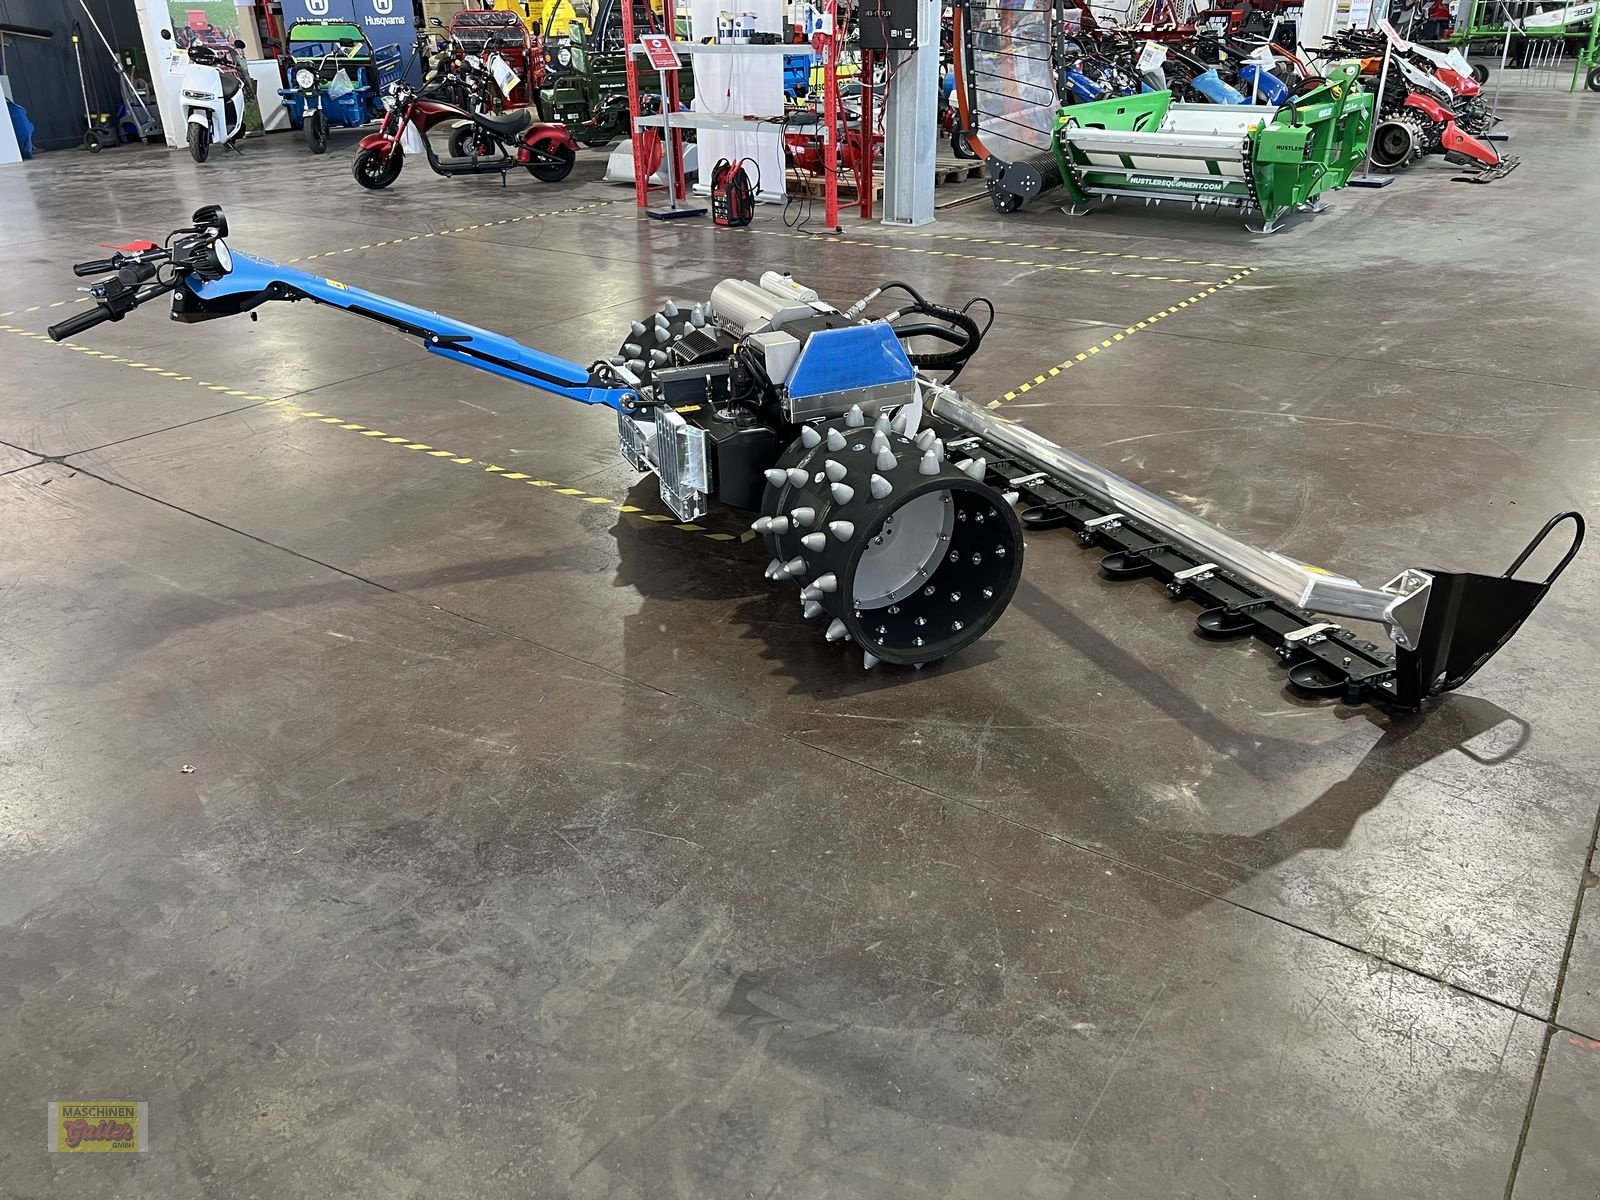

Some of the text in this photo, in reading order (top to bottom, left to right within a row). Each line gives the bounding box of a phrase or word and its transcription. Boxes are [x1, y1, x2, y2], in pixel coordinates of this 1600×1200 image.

[1574, 7, 1593, 17] 350
[364, 15, 406, 26] Husqvarna
[1130, 177, 1222, 190] HUSTLEREQUIPMENT.COM
